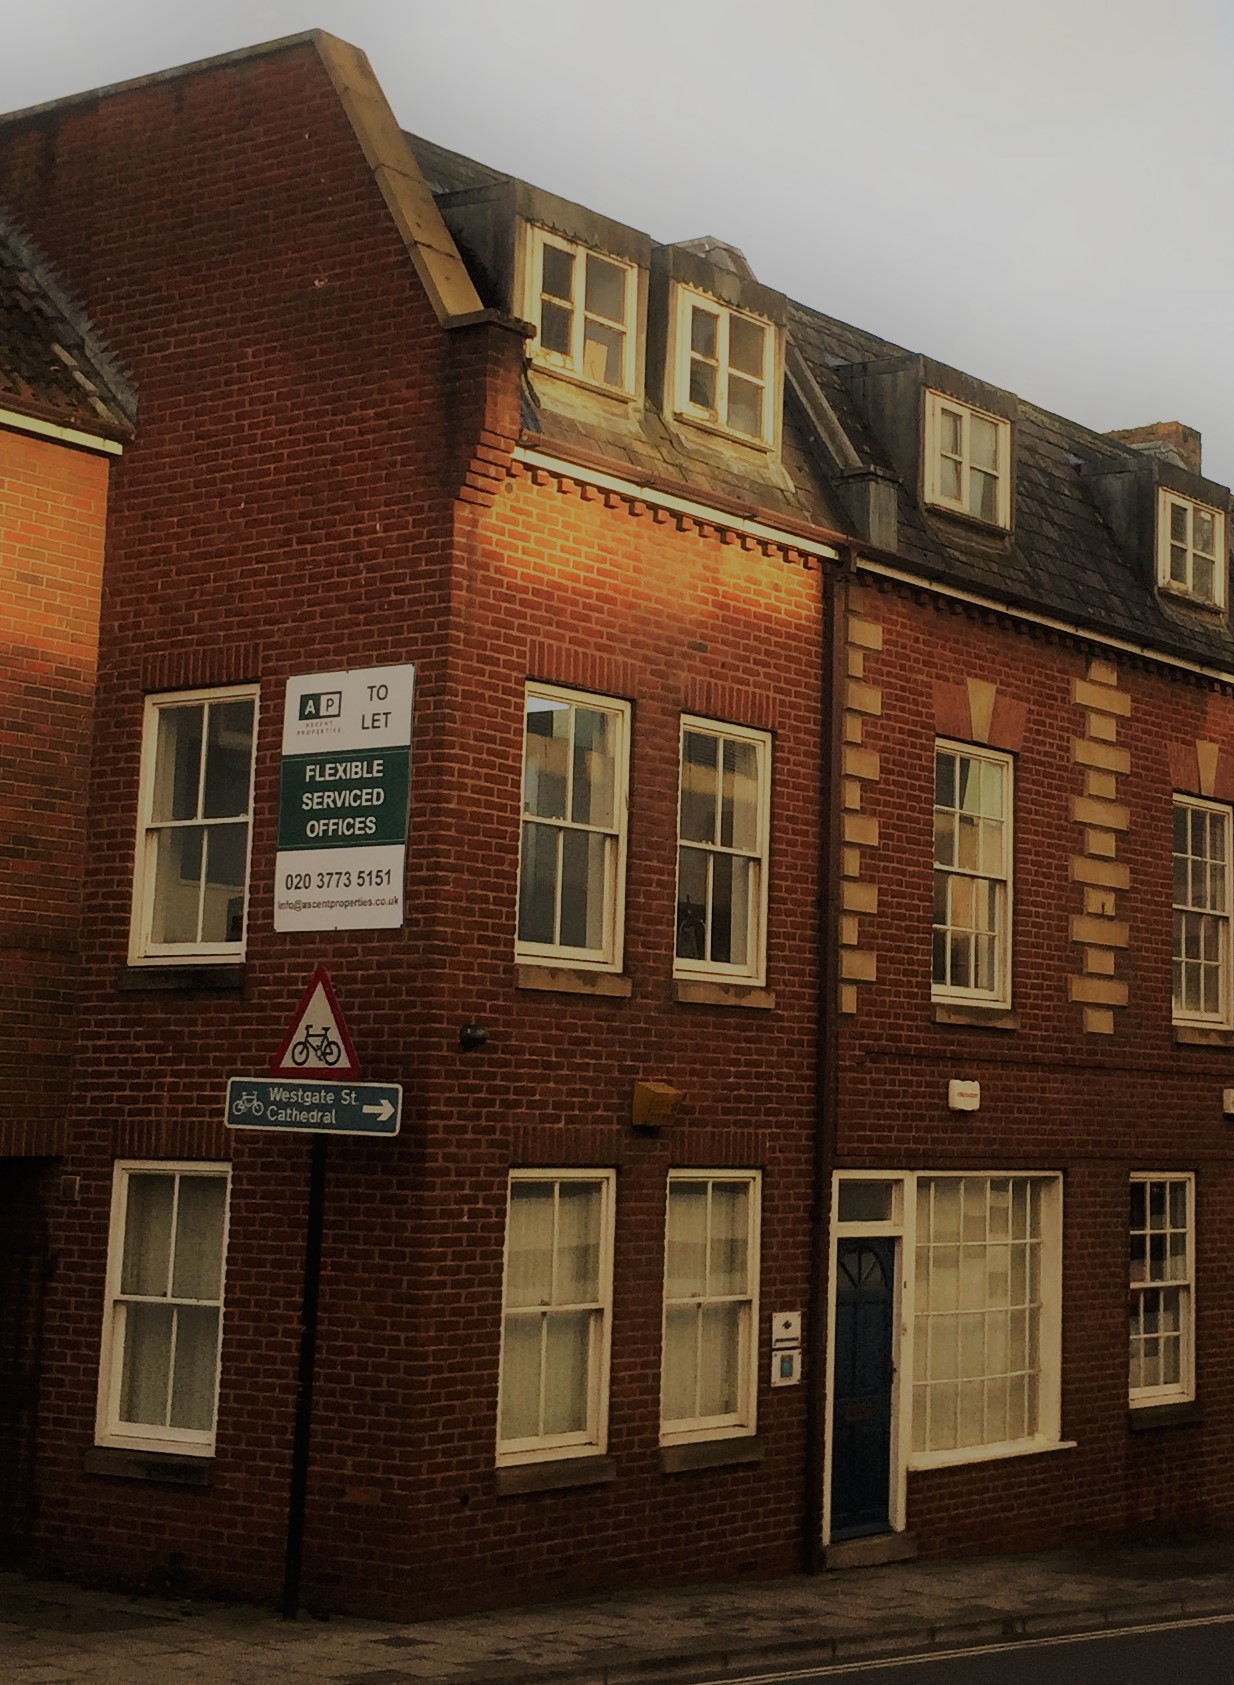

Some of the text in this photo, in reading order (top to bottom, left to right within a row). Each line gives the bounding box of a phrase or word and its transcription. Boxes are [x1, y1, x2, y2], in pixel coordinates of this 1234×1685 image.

[367, 685, 389, 701] TO
[361, 712, 391, 729] LET
[305, 760, 384, 783] FLEXIBLE
[302, 788, 385, 811] SERVICED
[306, 817, 376, 838] OFFICES
[285, 869, 391, 890] 020 3773 5151
[278, 896, 399, 912] info@ascentproperties.co.uk
[269, 1087, 335, 1106] Westgate
[266, 1105, 336, 1124] Cathedral
